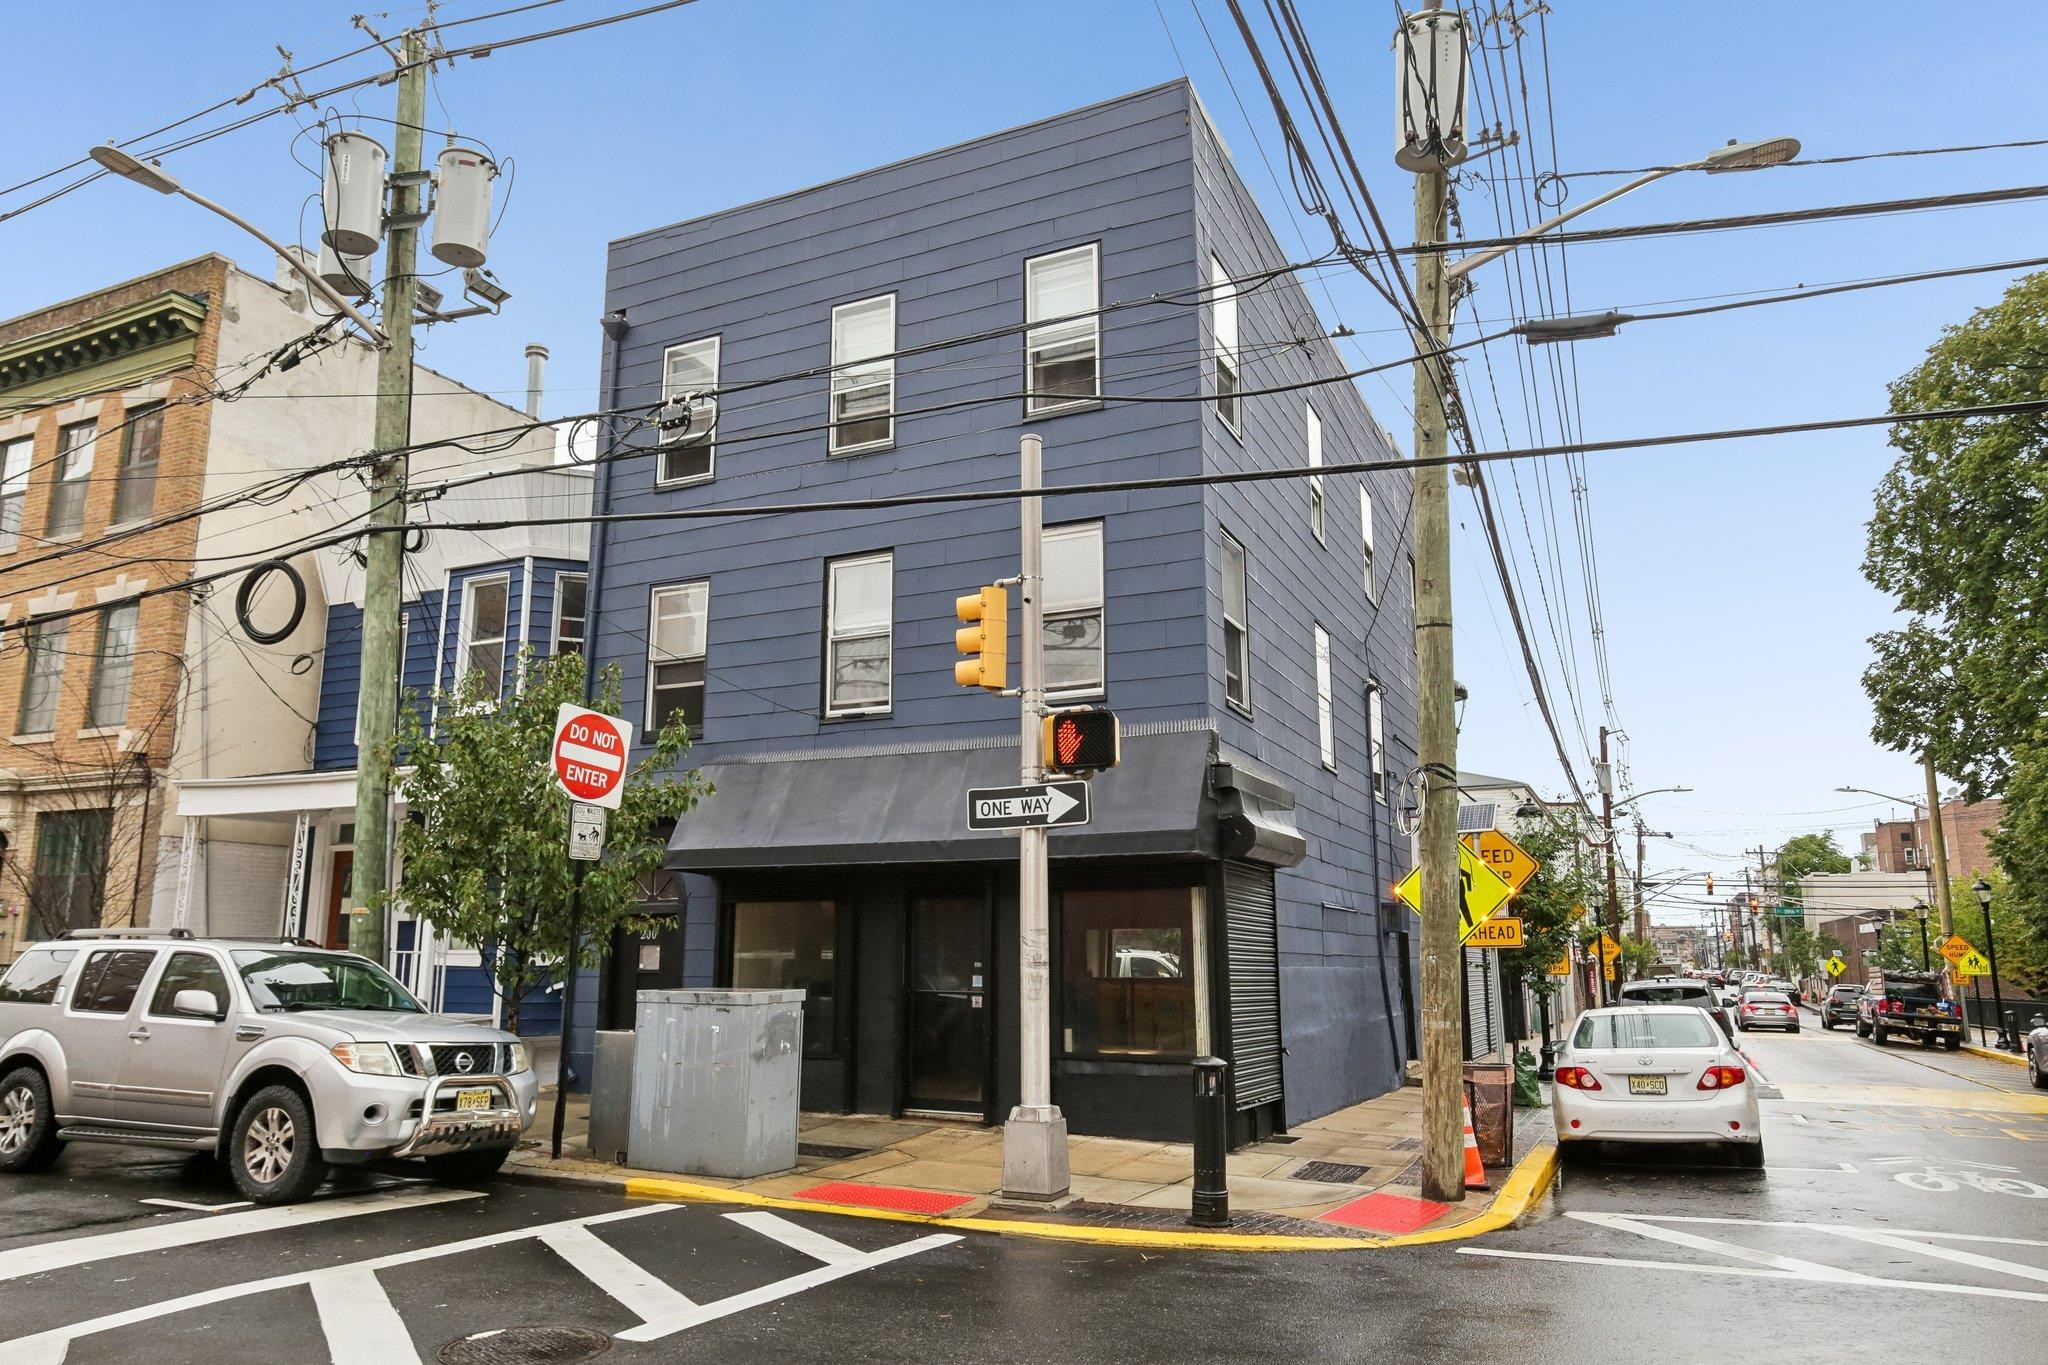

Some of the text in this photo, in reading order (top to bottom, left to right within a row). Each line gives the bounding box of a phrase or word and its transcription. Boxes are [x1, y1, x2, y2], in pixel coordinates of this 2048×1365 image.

[569, 723, 618, 750] DO NOT
[565, 764, 608, 789] ENTER
[980, 797, 1053, 817] ONE WAY
[1481, 849, 1515, 864] EED
